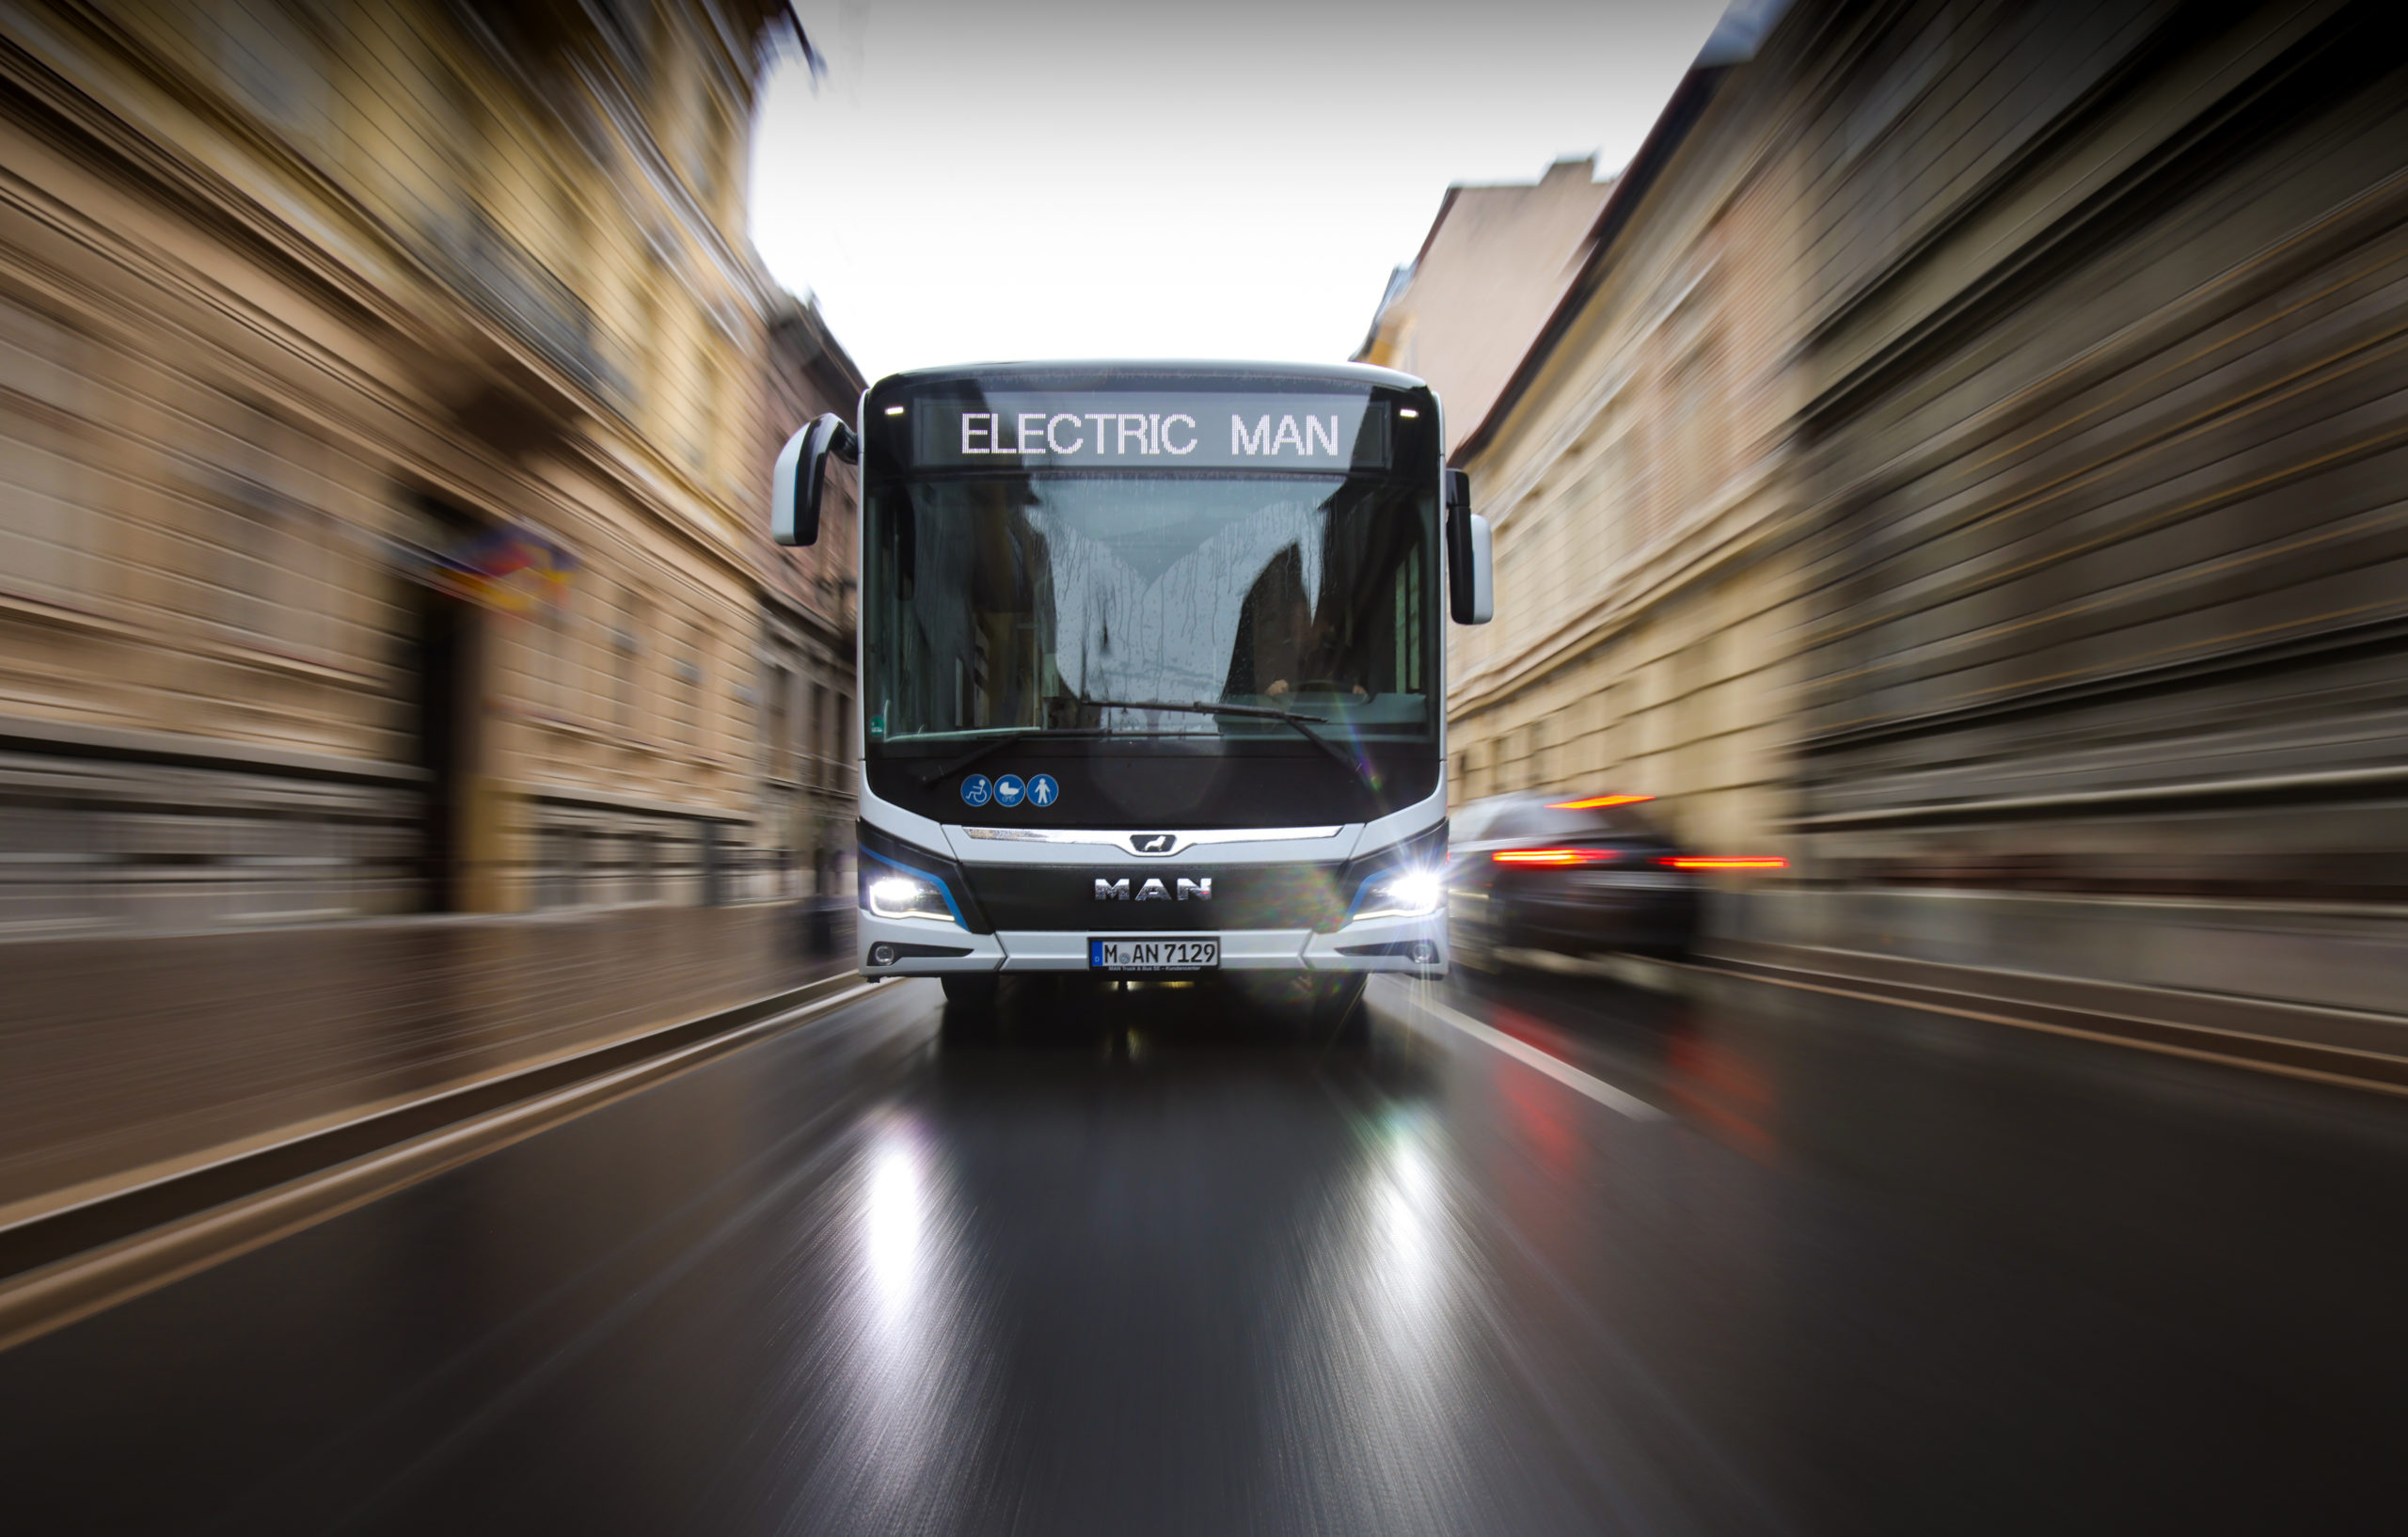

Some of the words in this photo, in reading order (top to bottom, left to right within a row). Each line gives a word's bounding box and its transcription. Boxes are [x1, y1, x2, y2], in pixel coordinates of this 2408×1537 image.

[961, 413, 1197, 454] ELECTRIC
[1231, 414, 1339, 456] MAN
[1095, 878, 1212, 901] MAN
[1133, 944, 1159, 963] AN
[1164, 943, 1215, 963] 7129
